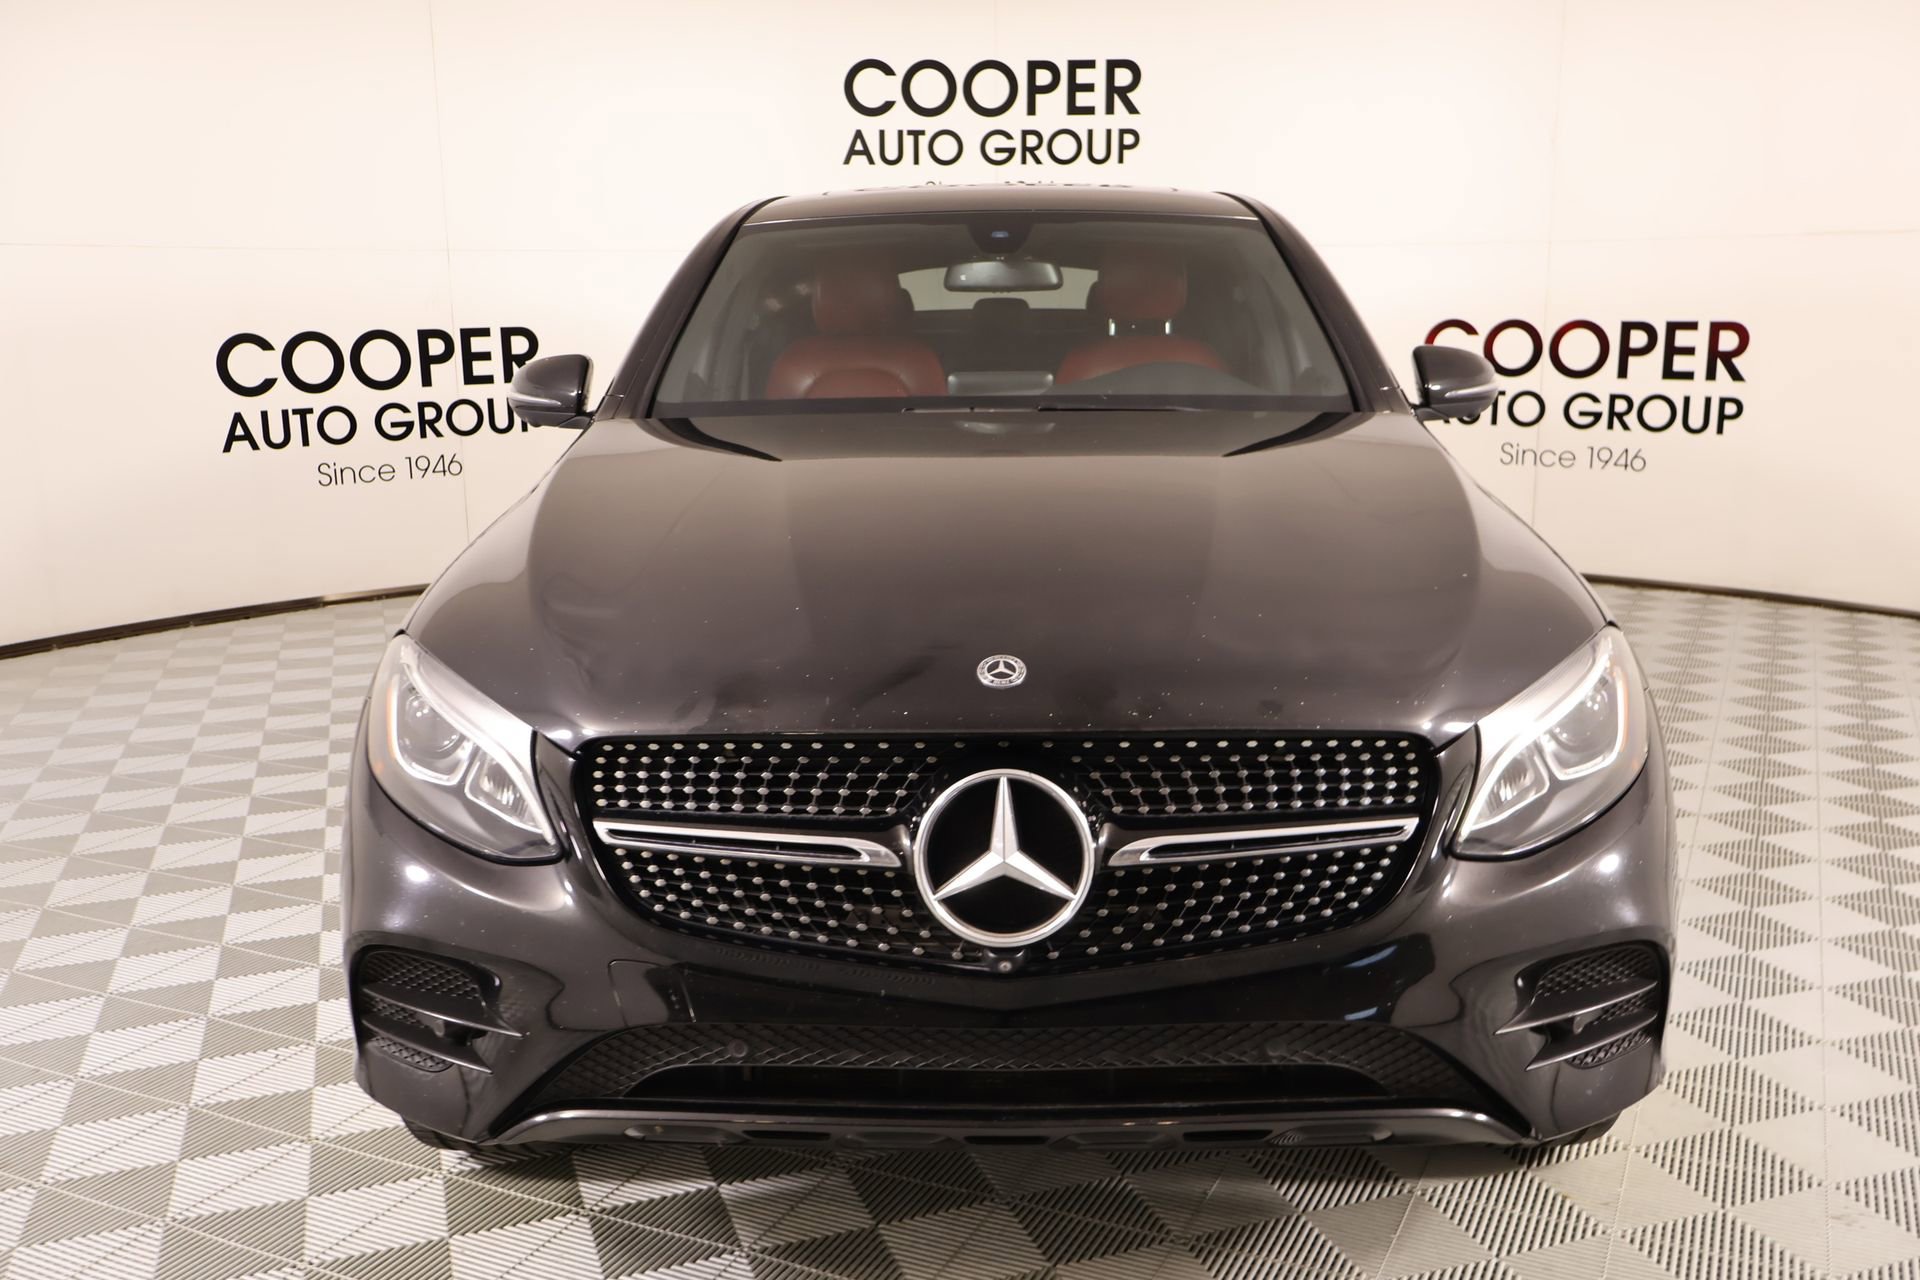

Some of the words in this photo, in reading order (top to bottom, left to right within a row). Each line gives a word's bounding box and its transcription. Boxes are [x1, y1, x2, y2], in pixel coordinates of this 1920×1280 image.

[844, 58, 1142, 117] COOPER
[843, 129, 964, 166] AUTO
[980, 128, 1141, 166] GROUP
[216, 326, 539, 397] COOPER
[222, 405, 358, 453] AUTO
[374, 397, 529, 441] GROU
[1443, 389, 1546, 428] TO
[1563, 391, 1745, 435] GROUP
[317, 460, 396, 487] Since
[405, 453, 463, 480] 1946
[1500, 442, 1576, 469] Since
[1586, 446, 1647, 473] 1946
